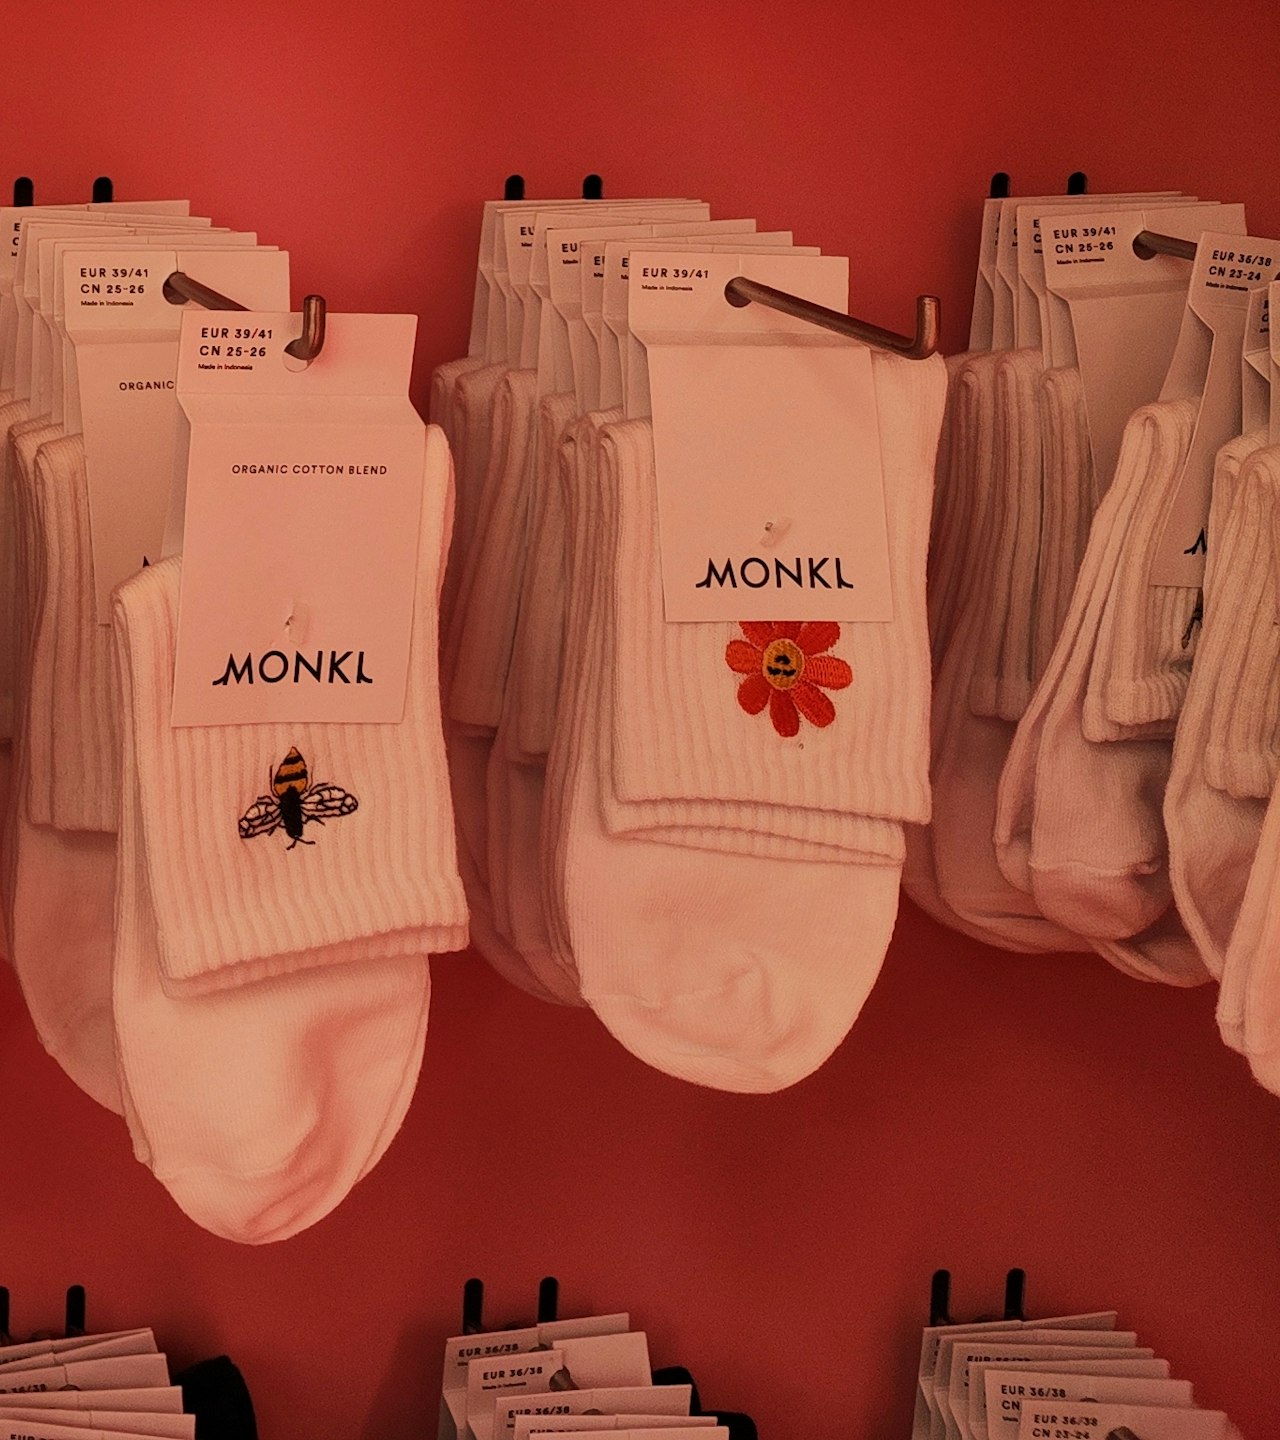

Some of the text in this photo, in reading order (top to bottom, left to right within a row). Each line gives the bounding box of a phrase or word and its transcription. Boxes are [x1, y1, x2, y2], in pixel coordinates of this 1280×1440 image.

[1053, 226, 1116, 239] EUR 39/41
[562, 243, 578, 252] EU
[1055, 242, 1114, 254] CN 25-26
[1212, 250, 1272, 267] EUR 36/38
[80, 267, 149, 278] EUR 39/41
[643, 268, 709, 278] EUR 39/41
[1209, 266, 1261, 281] CN 23-24
[80, 284, 145, 294] CN 25-26
[201, 327, 273, 339] EUR 39/41
[199, 346, 266, 357] CN 25-26
[119, 380, 174, 391] ORGANIC
[231, 464, 387, 475] ORGANIC COTTON BLEND
[458, 1348, 481, 1357] EUR
[483, 1367, 543, 1380] EUR 36/38
[1001, 1385, 1066, 1398] EUR 36/38
[1002, 1400, 1020, 1410] CN
[1034, 1415, 1058, 1424] EUR
[1033, 1428, 1051, 1438] CN
